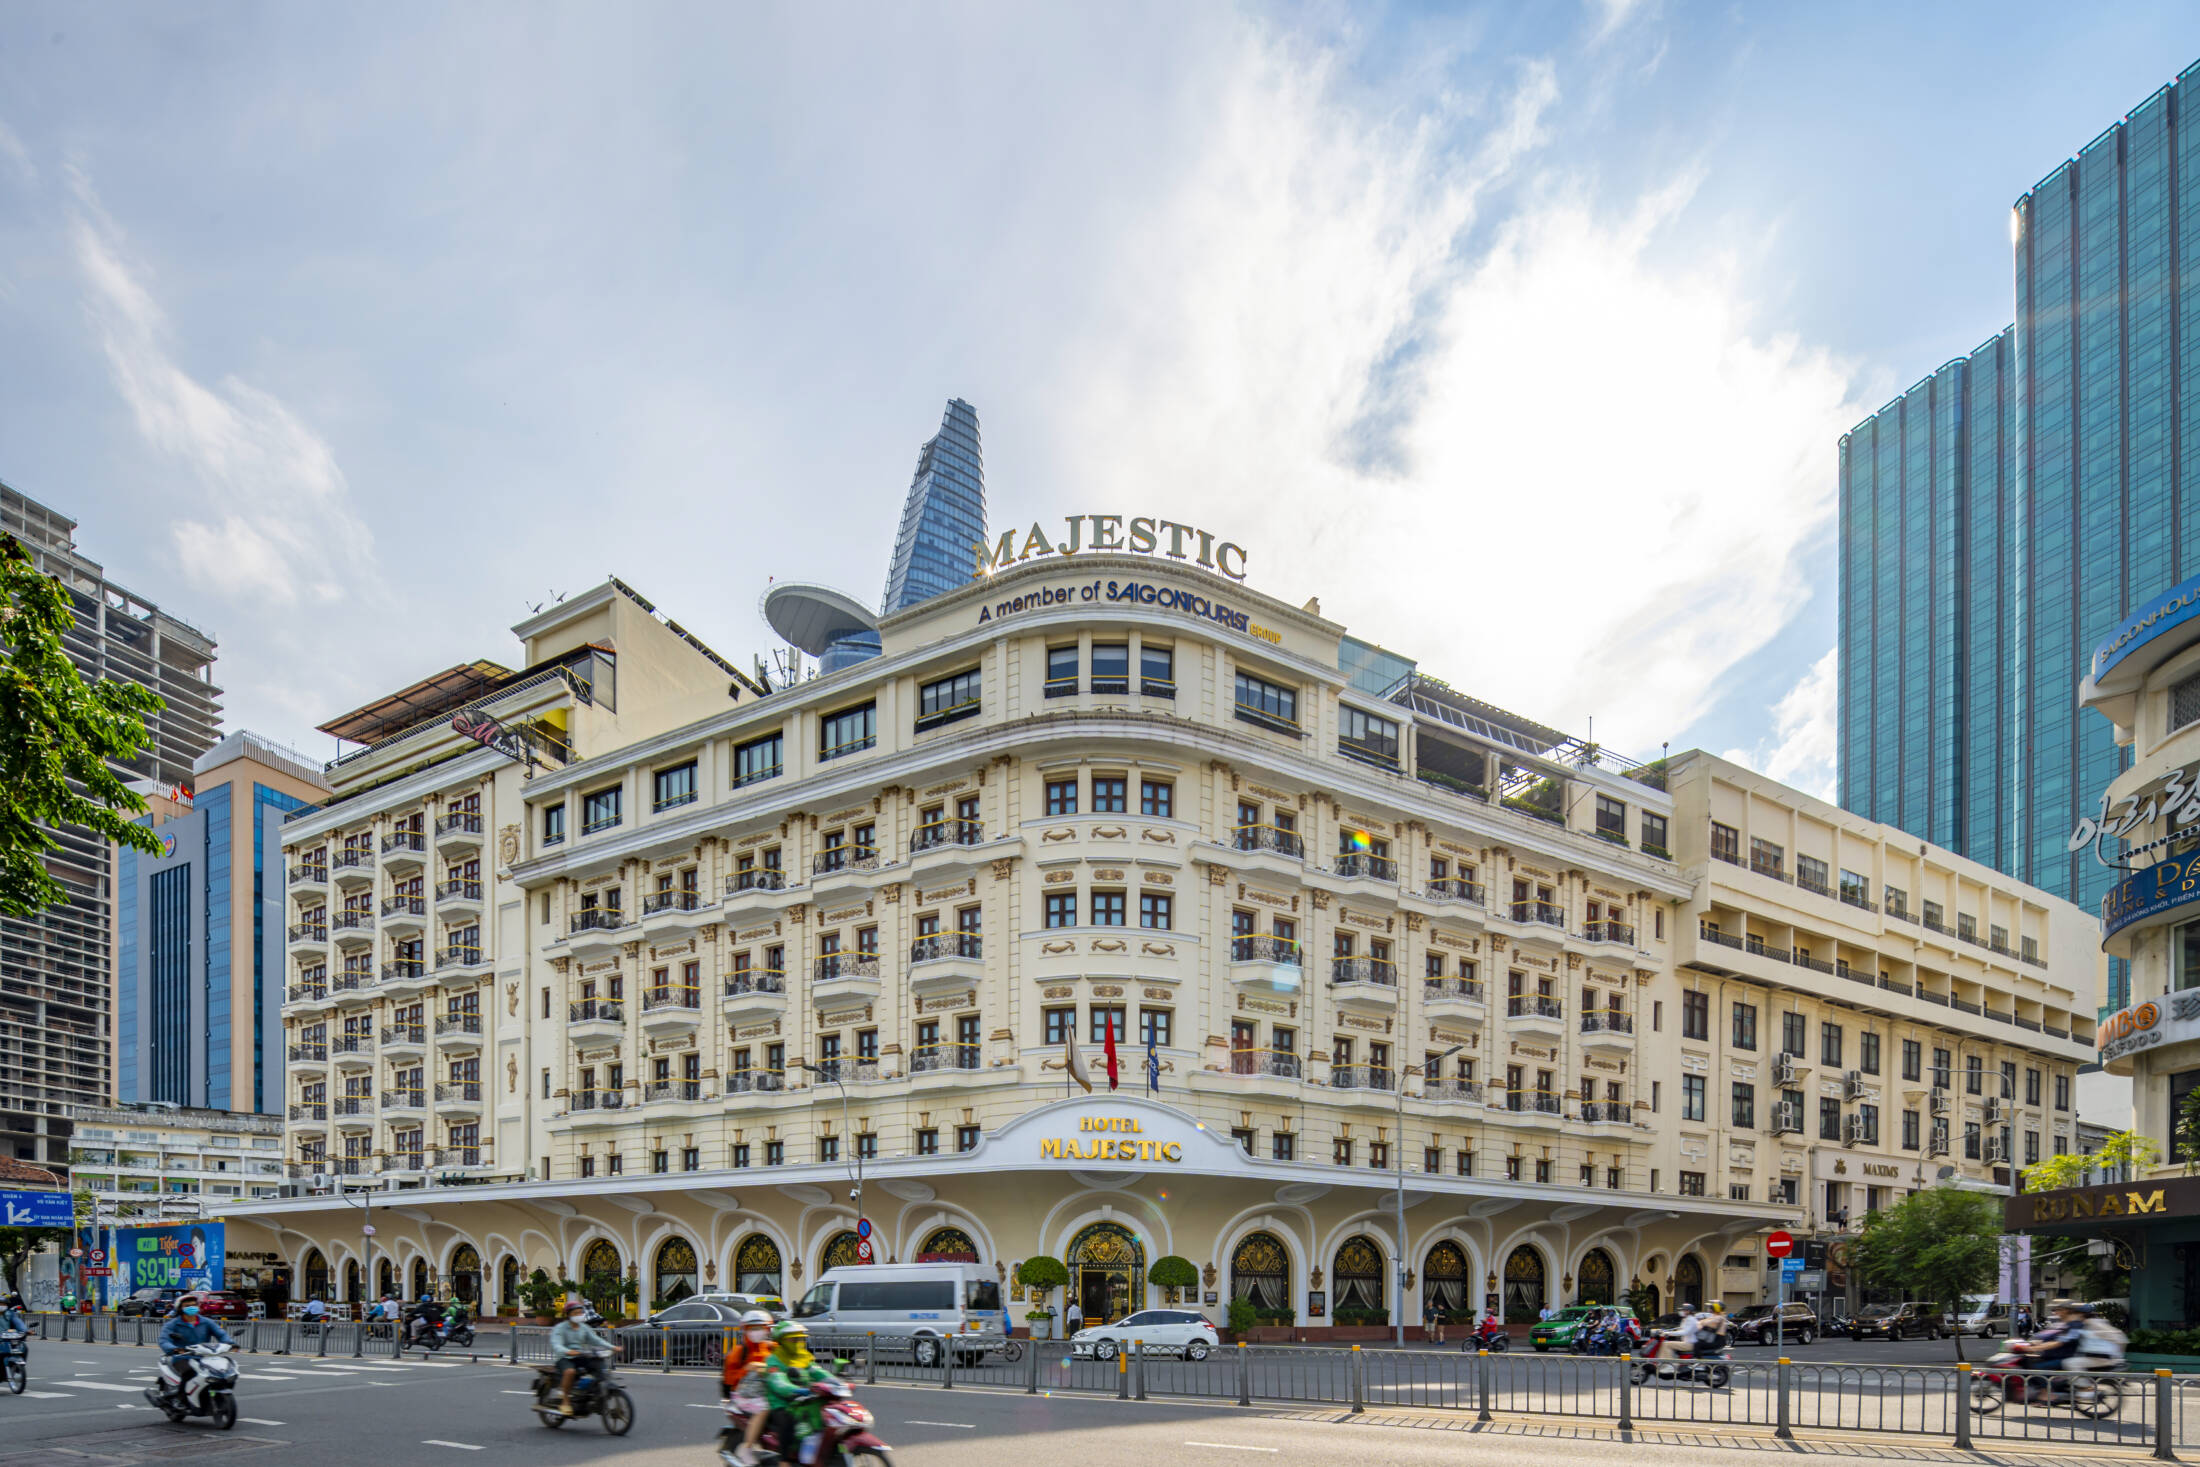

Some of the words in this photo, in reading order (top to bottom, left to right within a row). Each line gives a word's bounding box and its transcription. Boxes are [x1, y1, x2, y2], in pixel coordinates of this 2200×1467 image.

[972, 514, 1247, 580] MAJESTIC
[978, 605, 992, 625] A
[996, 584, 1076, 619] member
[1081, 580, 1102, 600] of
[1105, 580, 1250, 633] SAIGONTOURIST
[1249, 623, 1283, 645] GROUP
[2101, 586, 2200, 664] SAIGONHOU
[2118, 836, 2168, 861] KOREAN
[1079, 1116, 1144, 1133] HOTEL
[1040, 1138, 1182, 1162] MAJESTIC
[160, 1235, 179, 1256] Tiger
[136, 1257, 179, 1286] SOJU
